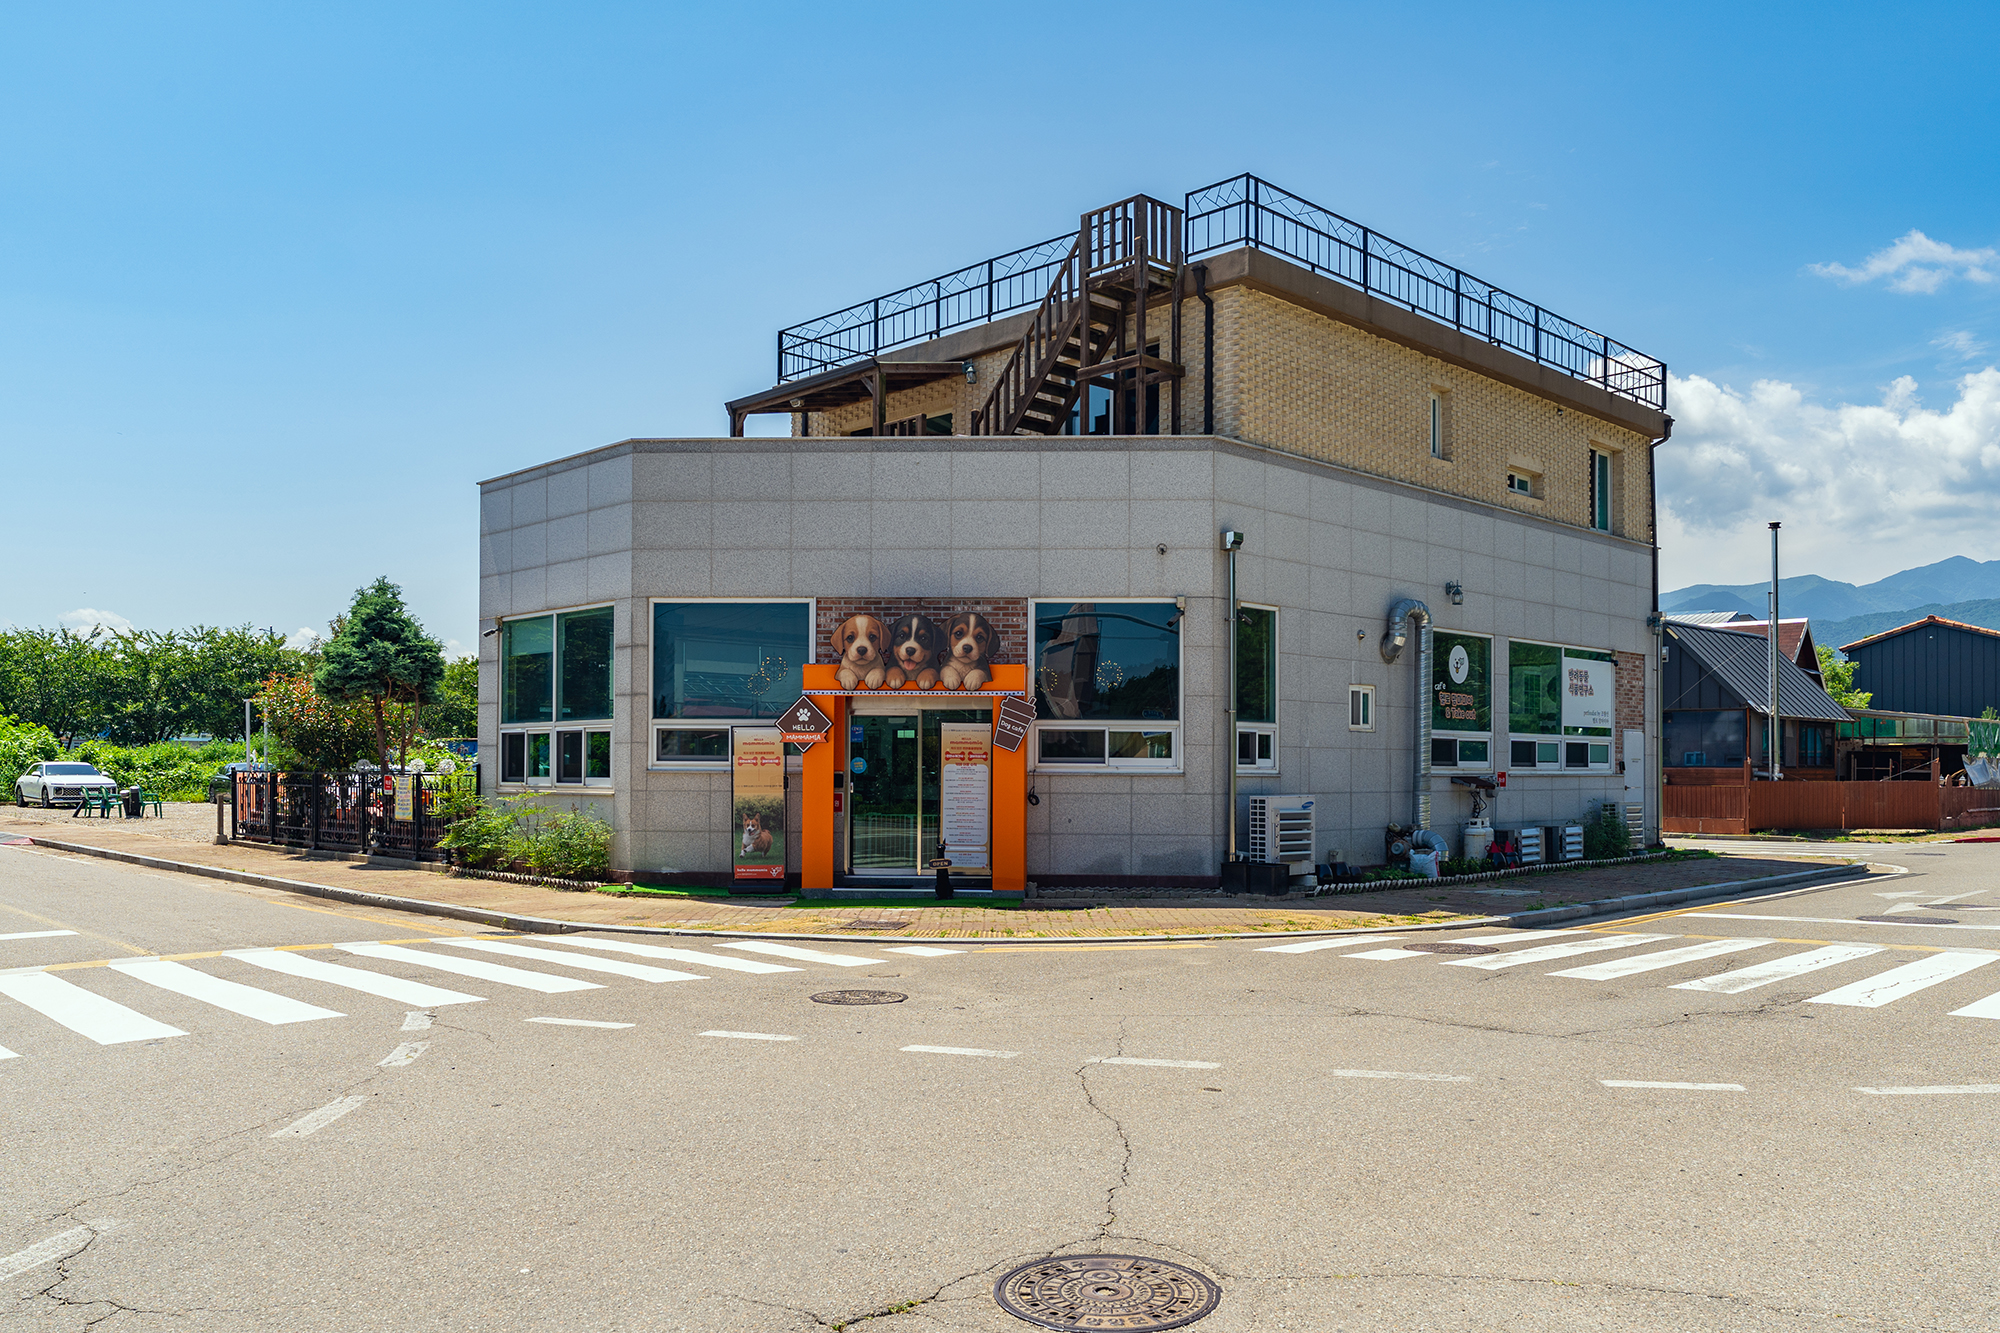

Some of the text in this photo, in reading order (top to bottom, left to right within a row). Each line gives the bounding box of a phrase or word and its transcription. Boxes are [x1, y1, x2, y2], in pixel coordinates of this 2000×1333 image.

[1568, 668, 1589, 683] 반려동물
[1434, 681, 1446, 690] cafe
[1568, 683, 1594, 697] 식품연구소
[1439, 691, 1451, 706] 헬로
[1451, 707, 1465, 719] Take
[1466, 709, 1476, 720] out
[1000, 720, 1024, 733] Dog cafe
